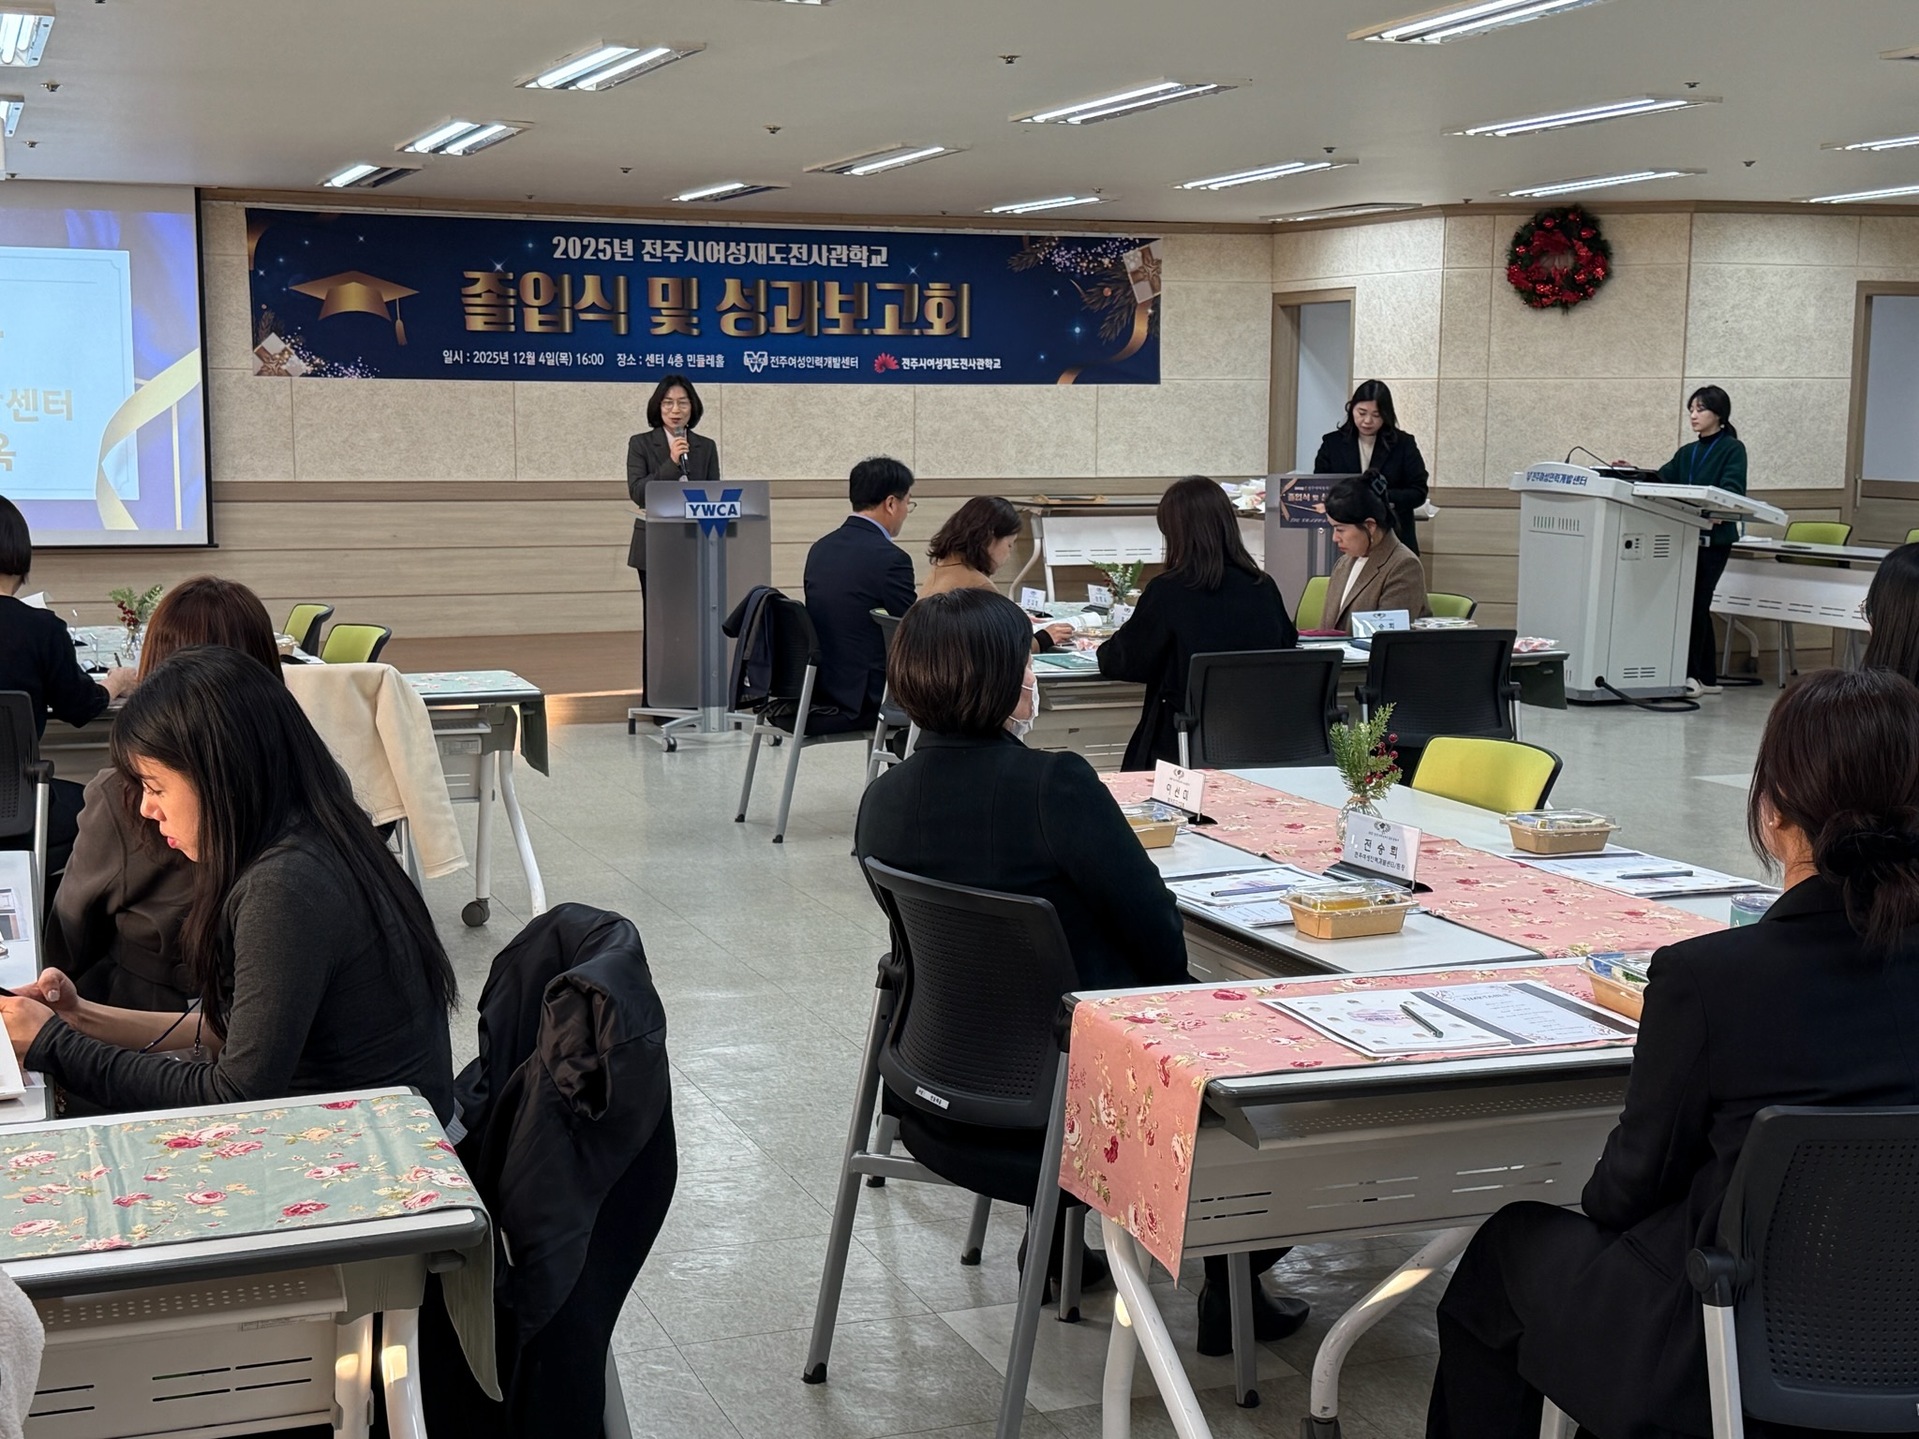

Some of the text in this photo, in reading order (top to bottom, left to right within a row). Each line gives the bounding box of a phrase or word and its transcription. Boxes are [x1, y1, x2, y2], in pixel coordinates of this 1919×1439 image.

[552, 236, 889, 268] 2025년 전주시여성재도전사관학교
[461, 270, 971, 338] 졸업식 및 성과보고회
[442, 350, 463, 364] 일시
[473, 351, 509, 365] 2025년
[513, 351, 536, 366] 12월
[538, 352, 573, 367] 4일(목)
[576, 353, 604, 366] 16:00
[616, 353, 637, 367] 장소
[645, 353, 665, 367] 센터
[667, 354, 684, 368] 4층
[687, 353, 725, 368] 민들레홀
[770, 356, 859, 369] 전주여성인력개발센터
[901, 357, 1001, 370] 전주시여성재도전사관학교
[0, 388, 73, 422] 센터
[689, 504, 738, 516] YWCA
